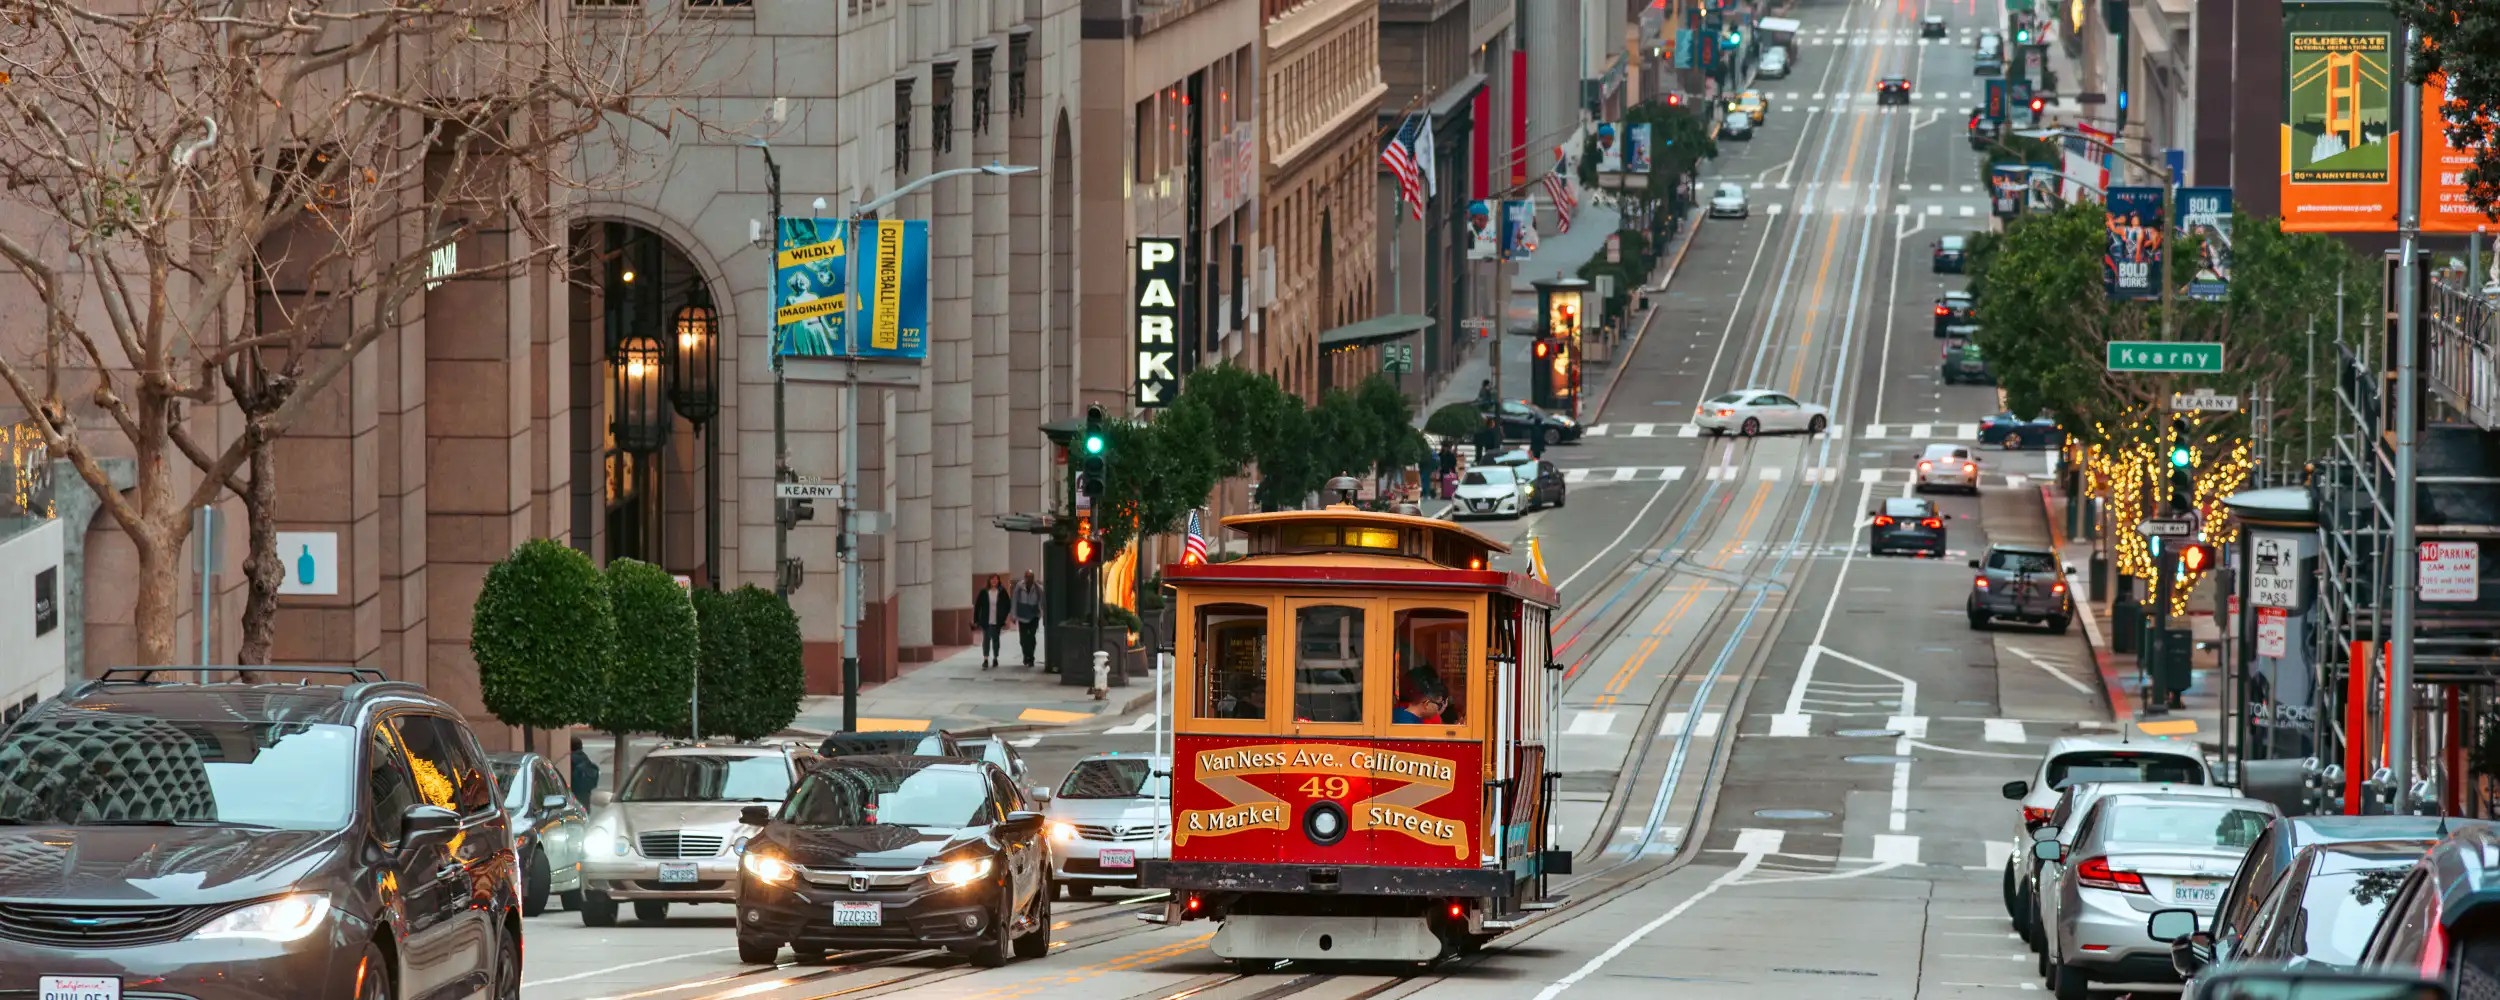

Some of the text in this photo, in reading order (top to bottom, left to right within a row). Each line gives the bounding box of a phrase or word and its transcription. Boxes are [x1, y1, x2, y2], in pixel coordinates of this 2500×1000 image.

[2349, 36, 2385, 45] GATE
[2315, 171, 2385, 180] ANNIVERSARY
[2189, 197, 2219, 213] BOLD
[791, 244, 836, 260] WILDLY
[2119, 262, 2148, 277] BOLD
[2119, 277, 2149, 288] WORKS
[779, 300, 844, 317] IMAGINATIVE
[1140, 241, 1175, 380] PARK
[2121, 348, 2208, 368] Kearny
[2175, 399, 2233, 408] KEARNY
[785, 486, 833, 496] KEARNY
[2422, 544, 2476, 560] NO PARKING
[2254, 577, 2294, 590] DO NOT
[2260, 591, 2288, 604] PASS
[1199, 753, 1236, 773] Van
[1238, 748, 1287, 769] Ness
[1350, 751, 1452, 782] California
[1298, 776, 1350, 799] 49
[1188, 805, 1282, 832] & Market
[1368, 807, 1455, 840] Streets
[2175, 887, 2216, 900] 8XTW785
[837, 910, 878, 922] 7ZZC333
